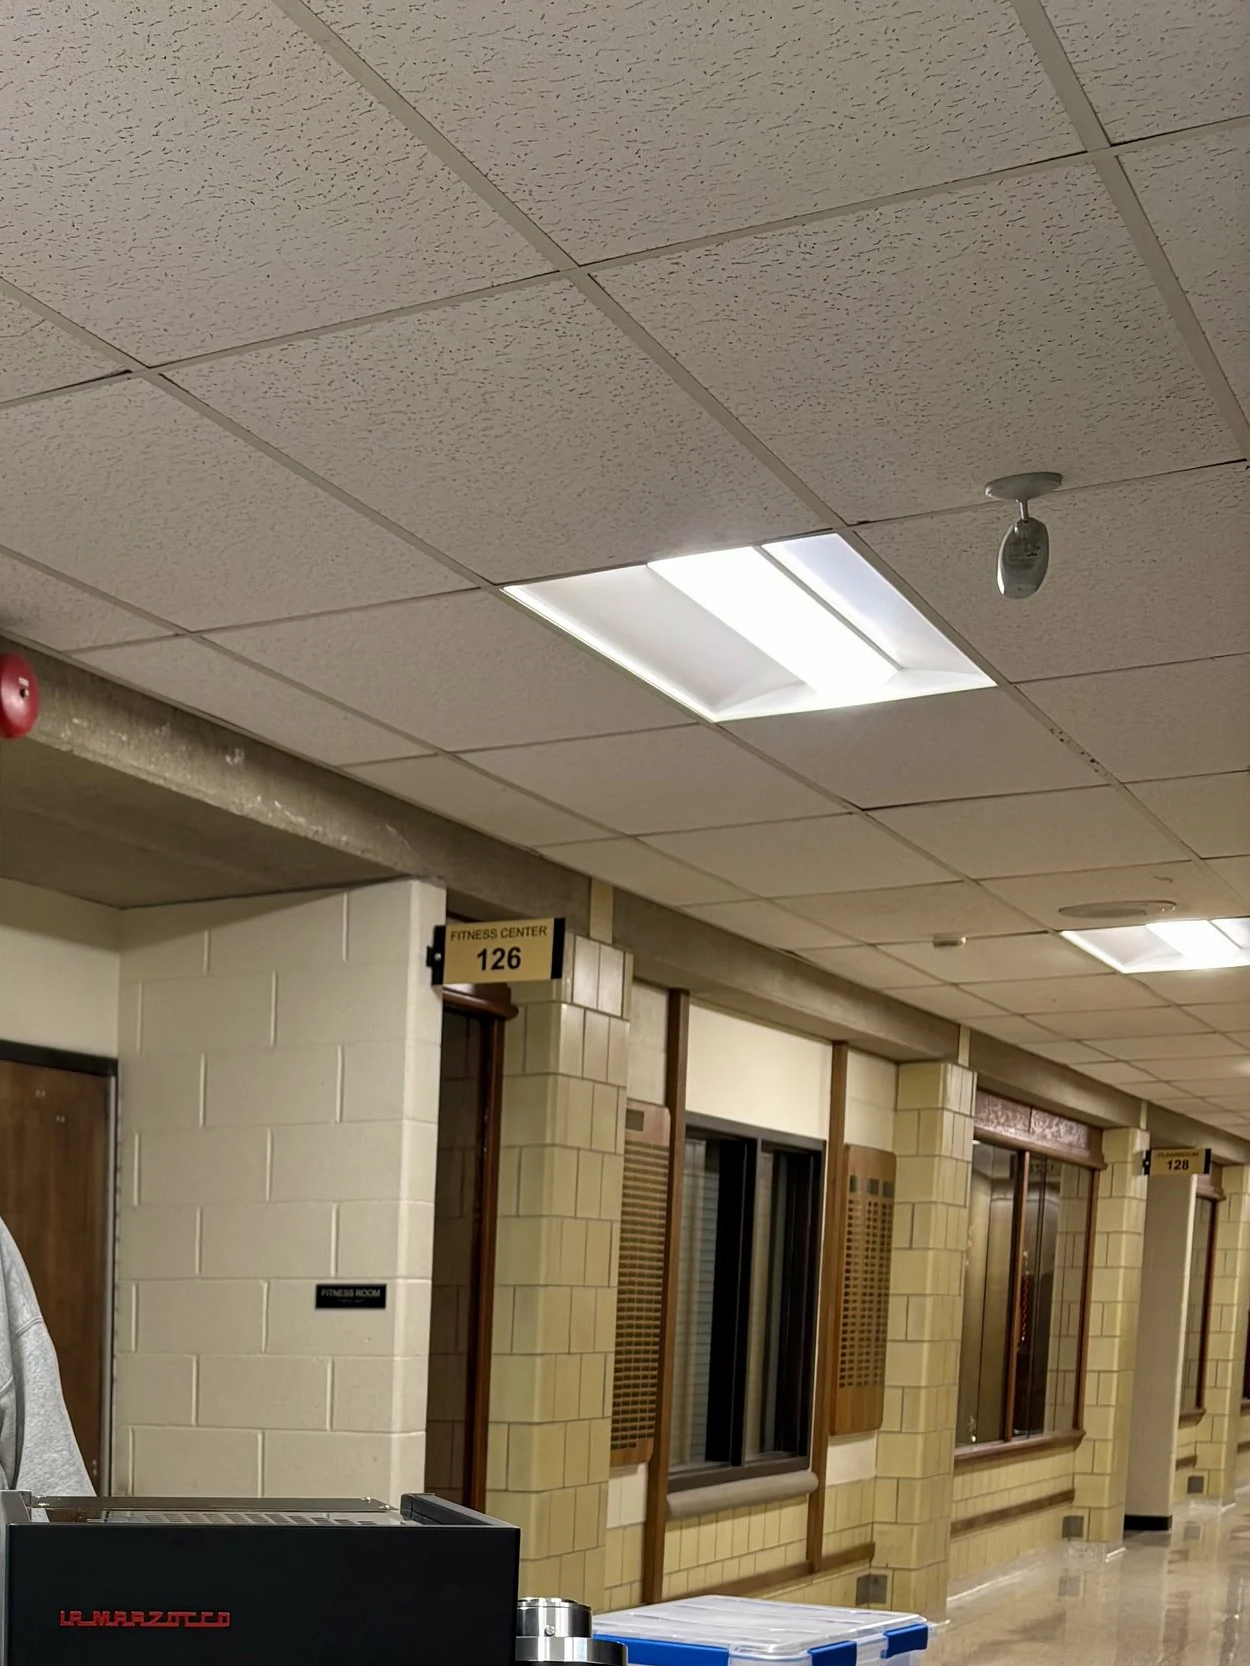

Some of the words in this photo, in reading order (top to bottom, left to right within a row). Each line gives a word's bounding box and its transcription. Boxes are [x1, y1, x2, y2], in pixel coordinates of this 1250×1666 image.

[450, 928, 498, 941] FITNESS
[500, 925, 548, 938] CENTER
[477, 946, 522, 971] 126
[1166, 1159, 1190, 1170] 128
